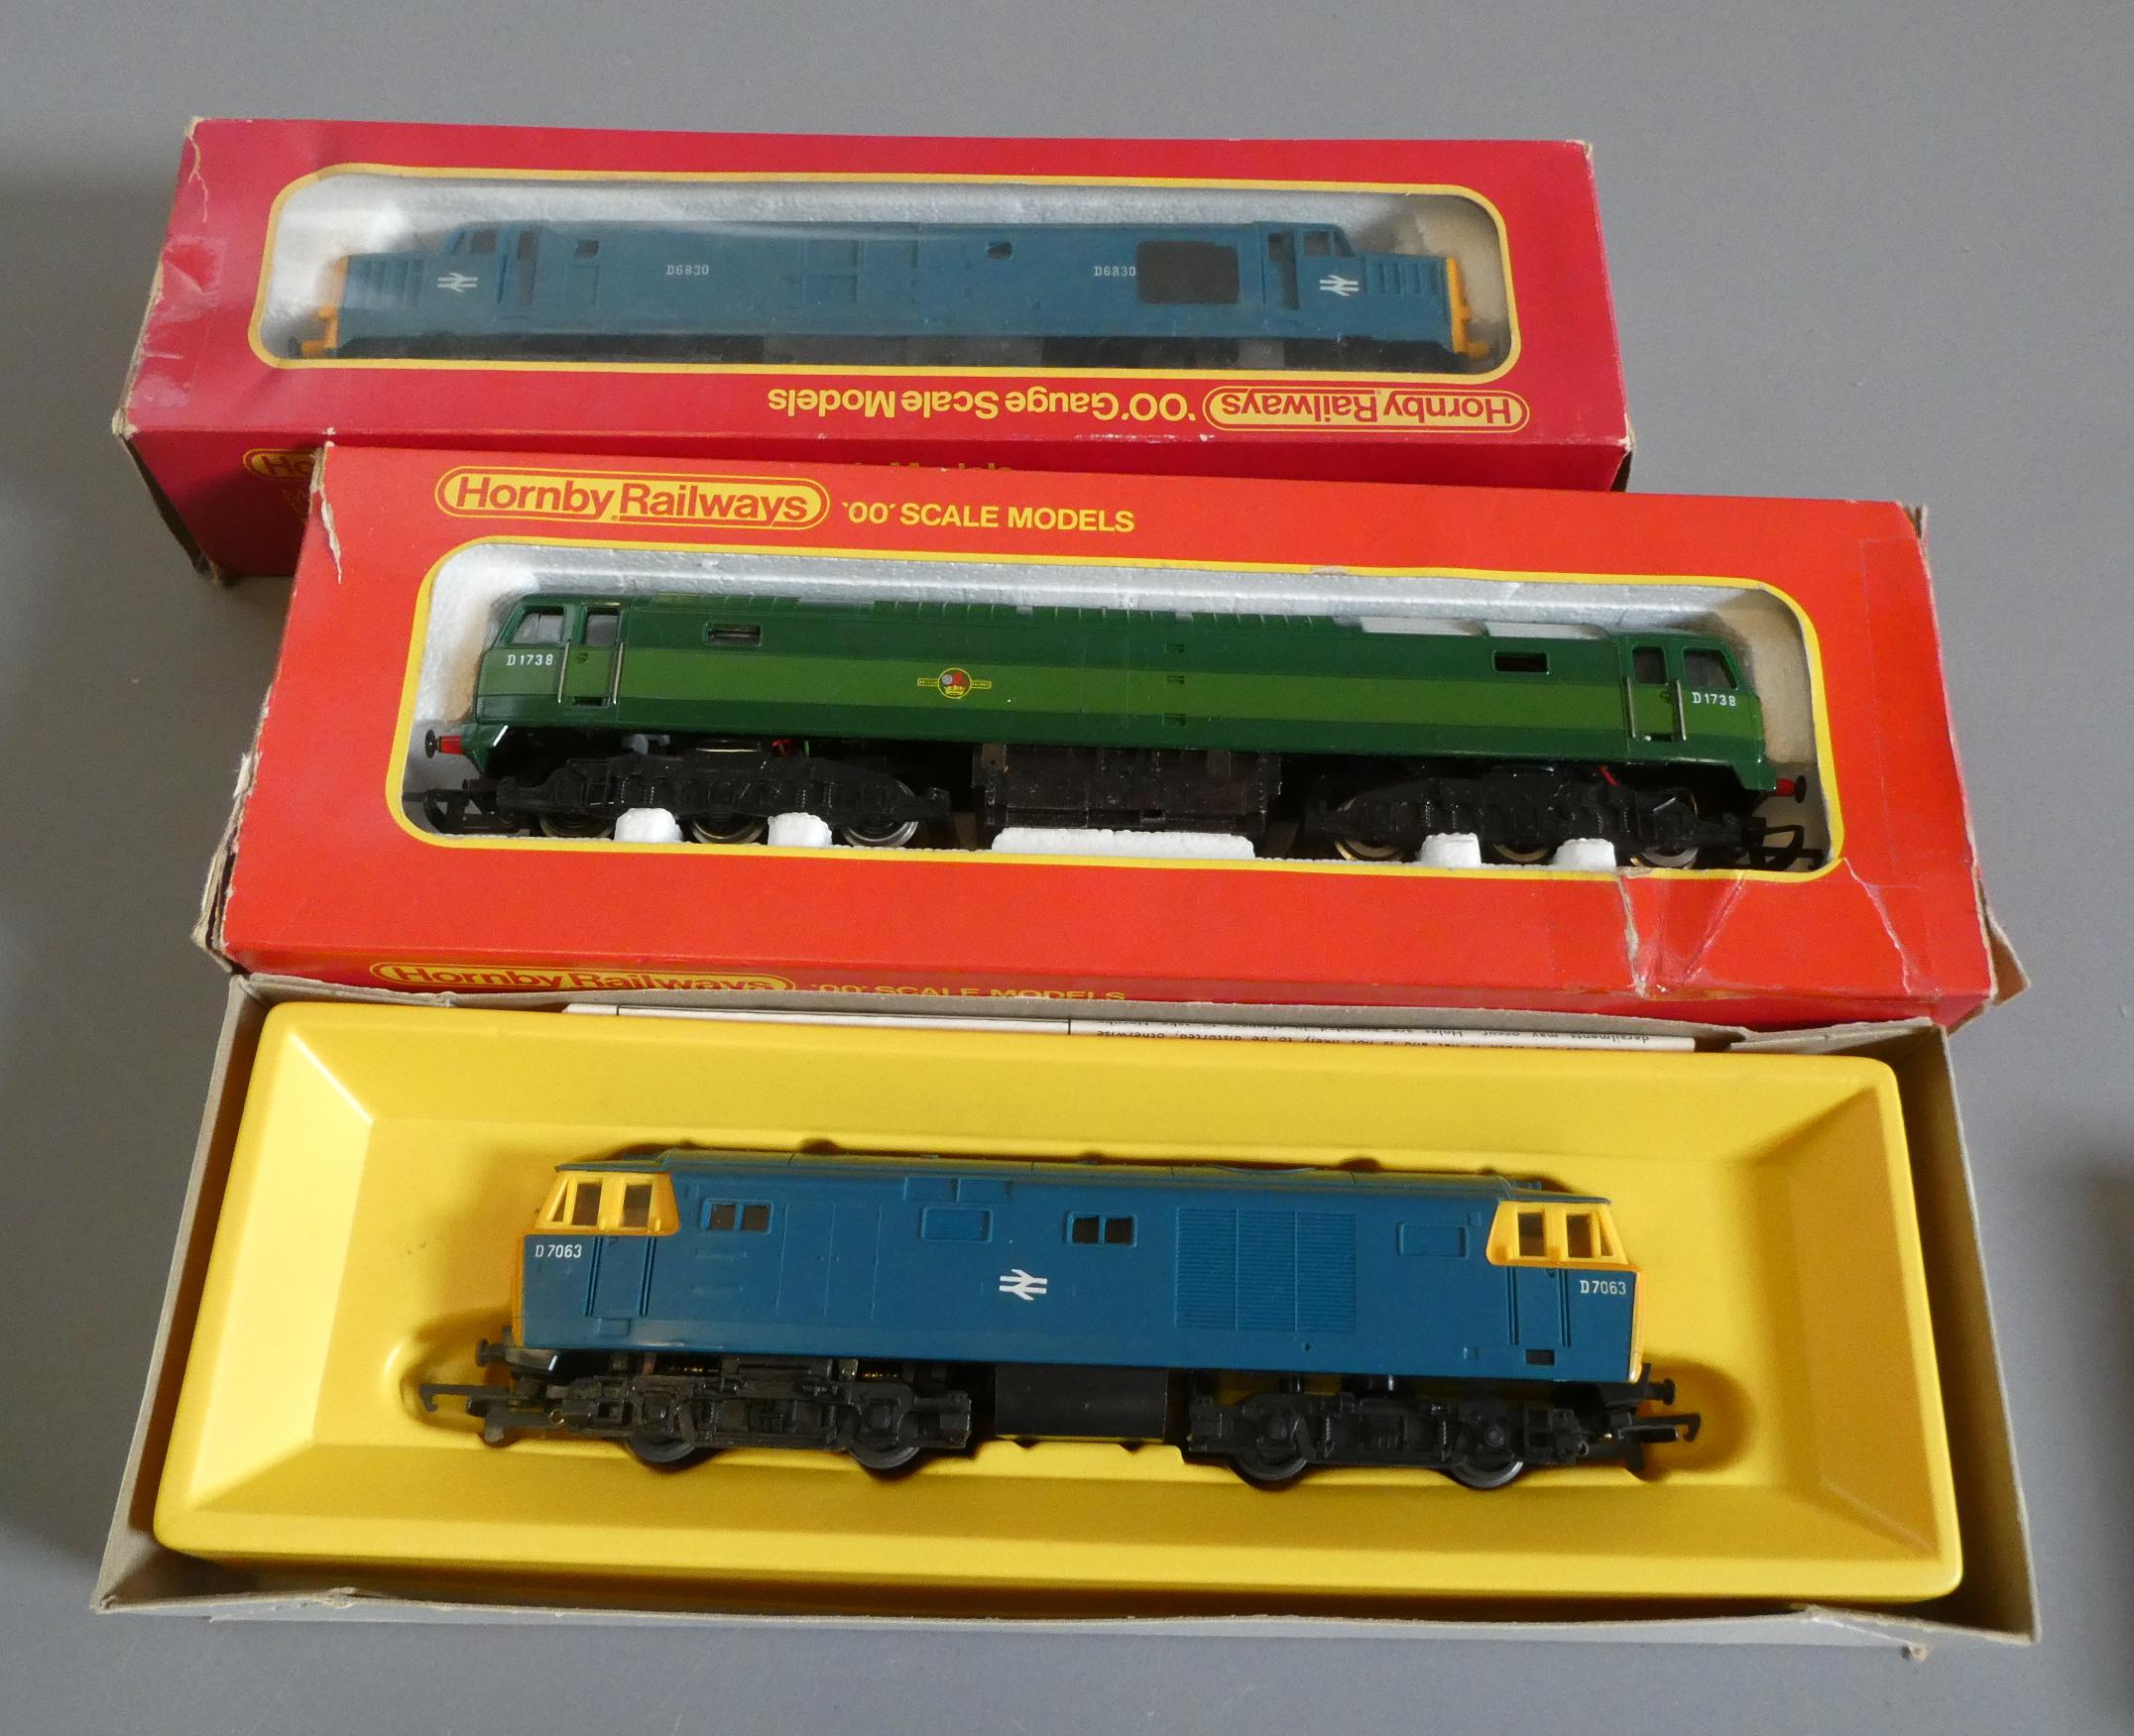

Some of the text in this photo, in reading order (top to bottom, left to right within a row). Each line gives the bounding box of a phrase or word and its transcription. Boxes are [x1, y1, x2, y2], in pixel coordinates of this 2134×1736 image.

[665, 264, 710, 276] D6830
[1094, 265, 1136, 277] D6830
[769, 388, 895, 418] Models
[900, 390, 999, 419] Scale
[1005, 387, 1120, 421] Gauge
[1220, 388, 1377, 423] Railways
[1384, 391, 1512, 424] Hornby
[455, 476, 615, 517] Hornby
[620, 482, 808, 526] Railways
[899, 503, 1000, 528] SCALE
[1008, 507, 1135, 532] MODELS
[506, 653, 553, 666] D1738
[1692, 691, 1736, 707] D1738
[396, 967, 564, 989] Hornby
[568, 974, 775, 990] Railways
[1580, 1280, 1626, 1295] D7063
